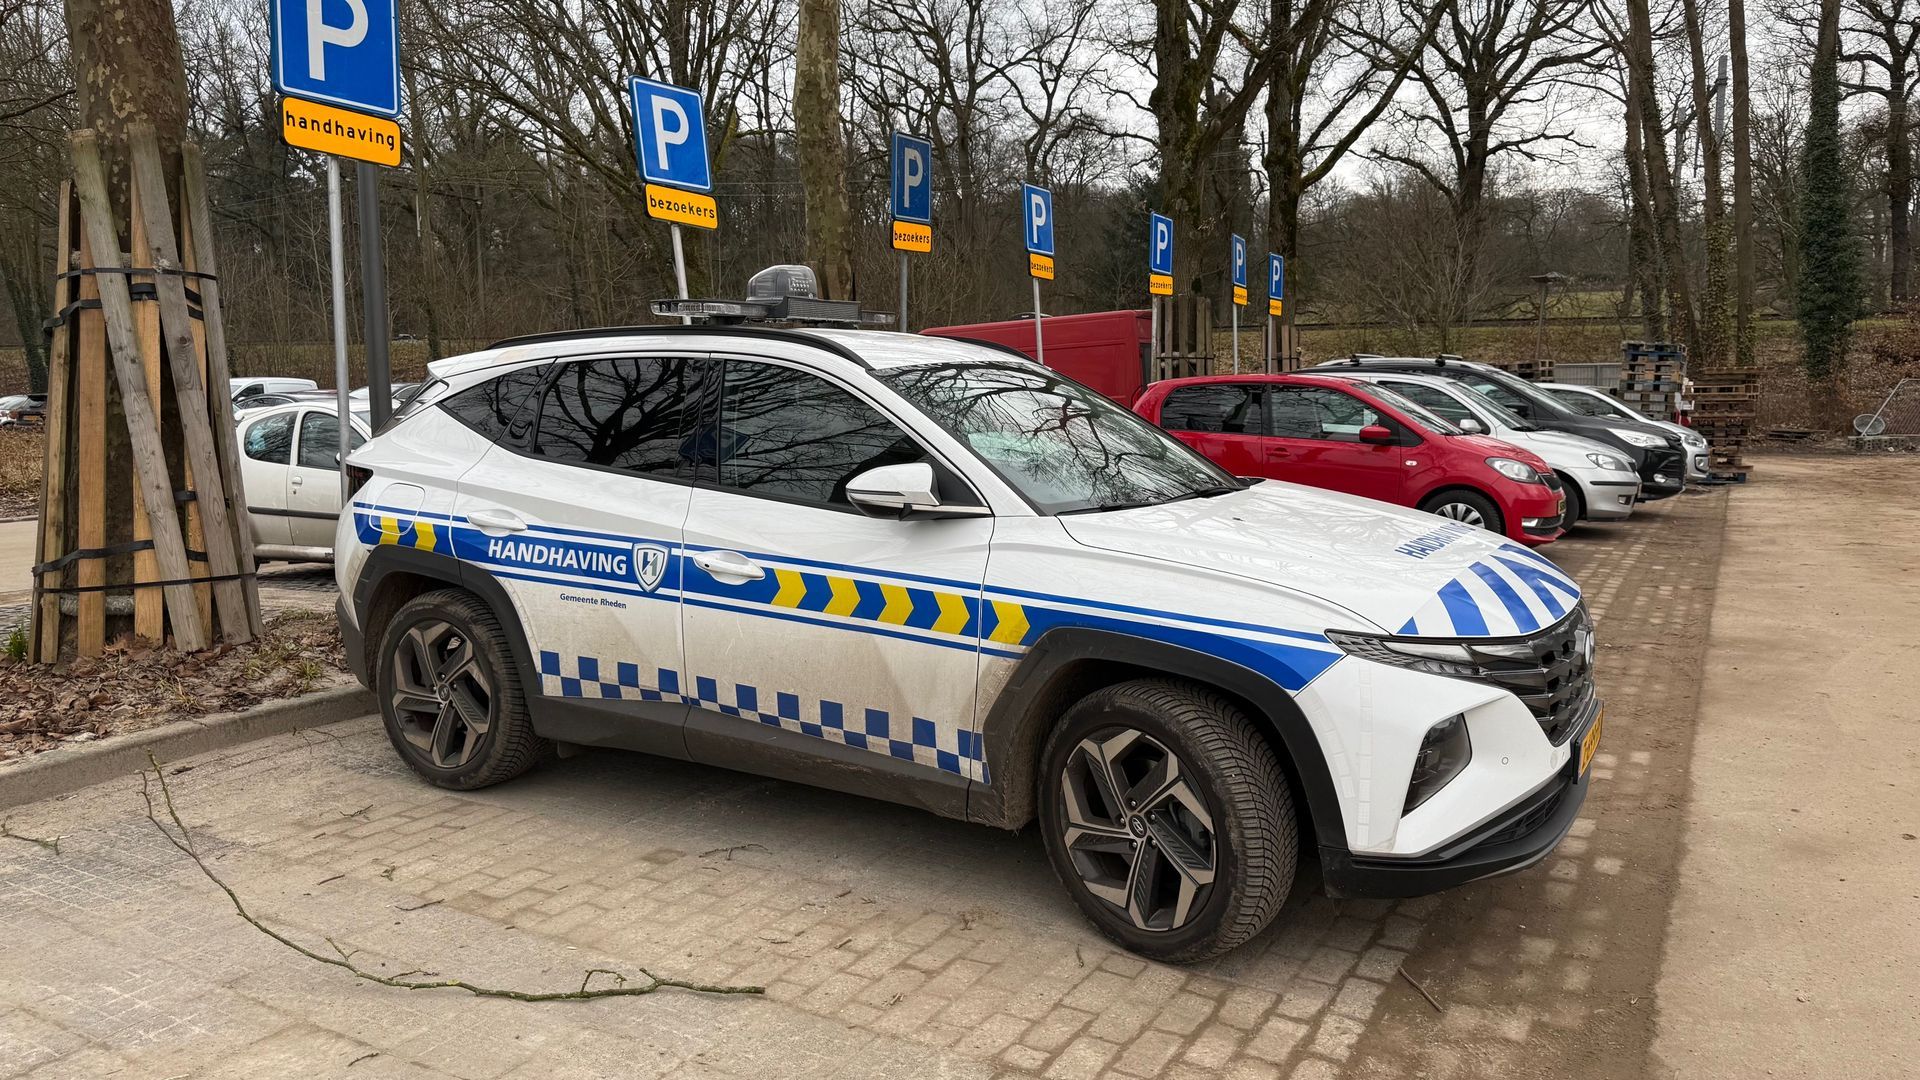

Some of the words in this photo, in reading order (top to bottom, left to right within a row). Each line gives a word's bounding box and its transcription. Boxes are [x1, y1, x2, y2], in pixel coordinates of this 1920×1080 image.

[306, 0, 369, 81] P
[285, 111, 395, 151] handhaving
[651, 94, 690, 171] P
[903, 147, 924, 208] P
[649, 194, 715, 219] bezoekers
[1031, 193, 1047, 244] P
[894, 230, 931, 244] bezoekers
[1156, 222, 1169, 265] P
[1030, 262, 1054, 274] bezoekers
[1236, 242, 1244, 279] P
[1272, 259, 1281, 293] P
[488, 539, 627, 575] HANDHAVING
[1394, 522, 1477, 560] HANDHAV
[559, 592, 599, 605] Gemeente
[600, 598, 627, 609] Rheden
